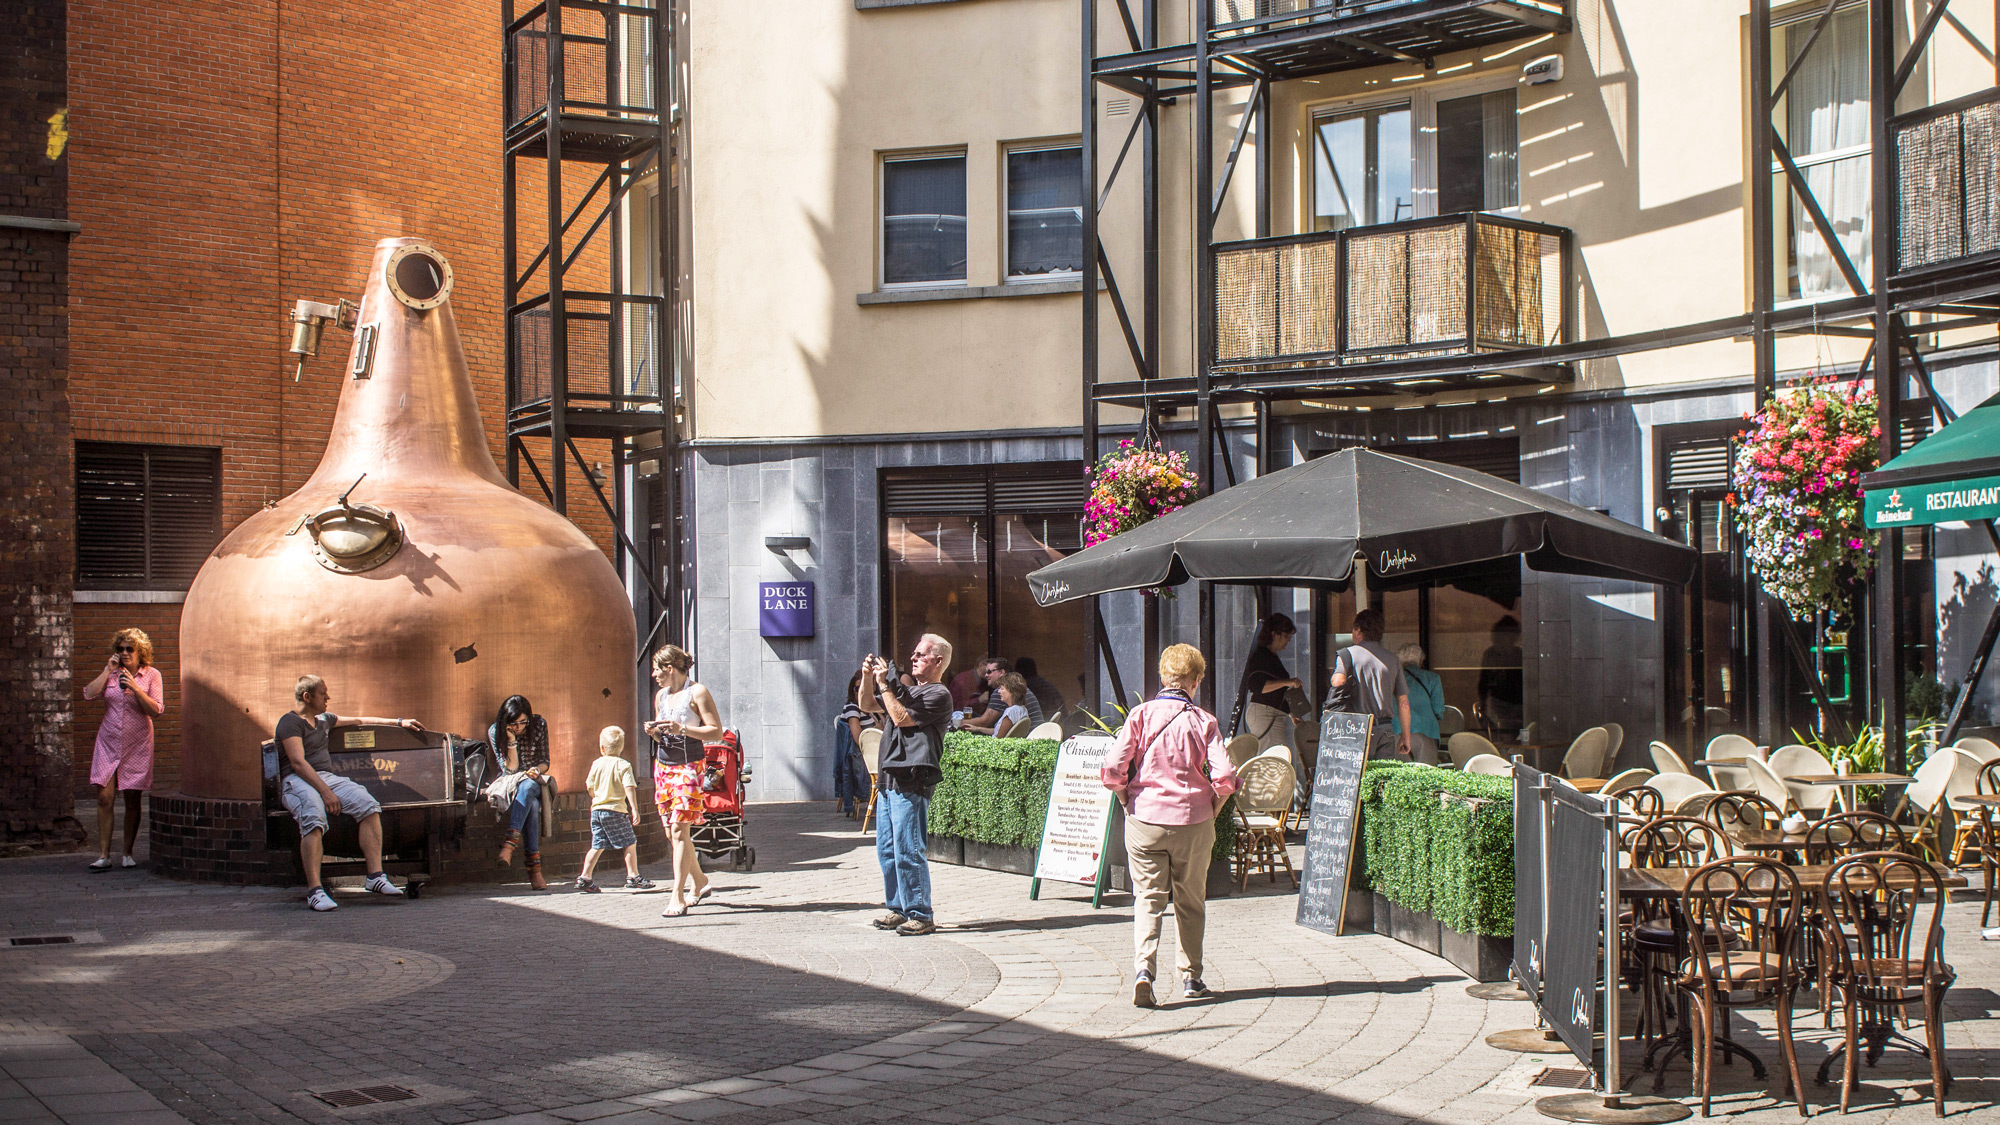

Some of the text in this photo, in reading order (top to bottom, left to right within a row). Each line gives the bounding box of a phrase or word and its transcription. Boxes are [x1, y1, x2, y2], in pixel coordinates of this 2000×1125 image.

[1876, 508, 1912, 523] Heineken
[764, 587, 807, 598] DUCK
[764, 600, 808, 610] LANE
[331, 758, 398, 773] AMESON
